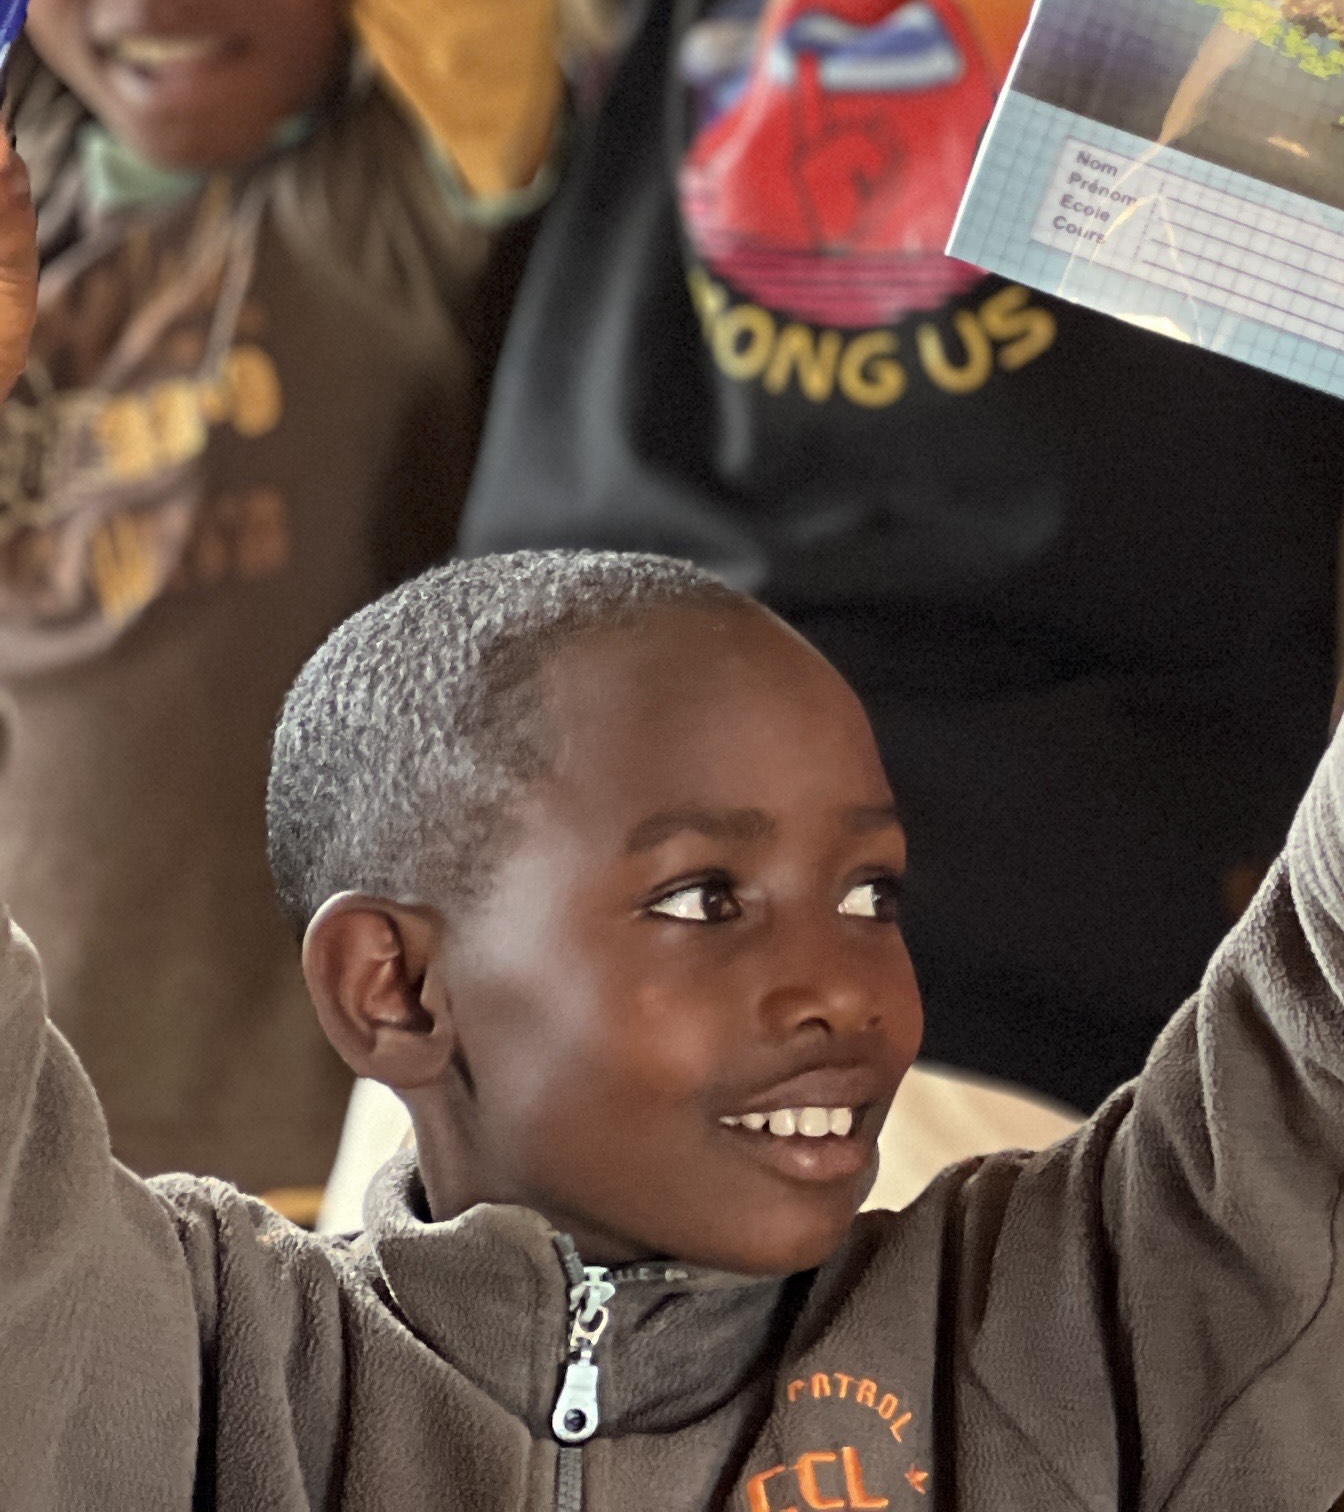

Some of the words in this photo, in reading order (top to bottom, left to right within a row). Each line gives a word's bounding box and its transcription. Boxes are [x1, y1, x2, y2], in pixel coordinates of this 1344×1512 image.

[1076, 150, 1118, 177] Nom
[1068, 171, 1138, 206] Prénom
[1060, 193, 1111, 223] Ecole
[916, 287, 1058, 394] US
[786, 1372, 913, 1444] PATROL
